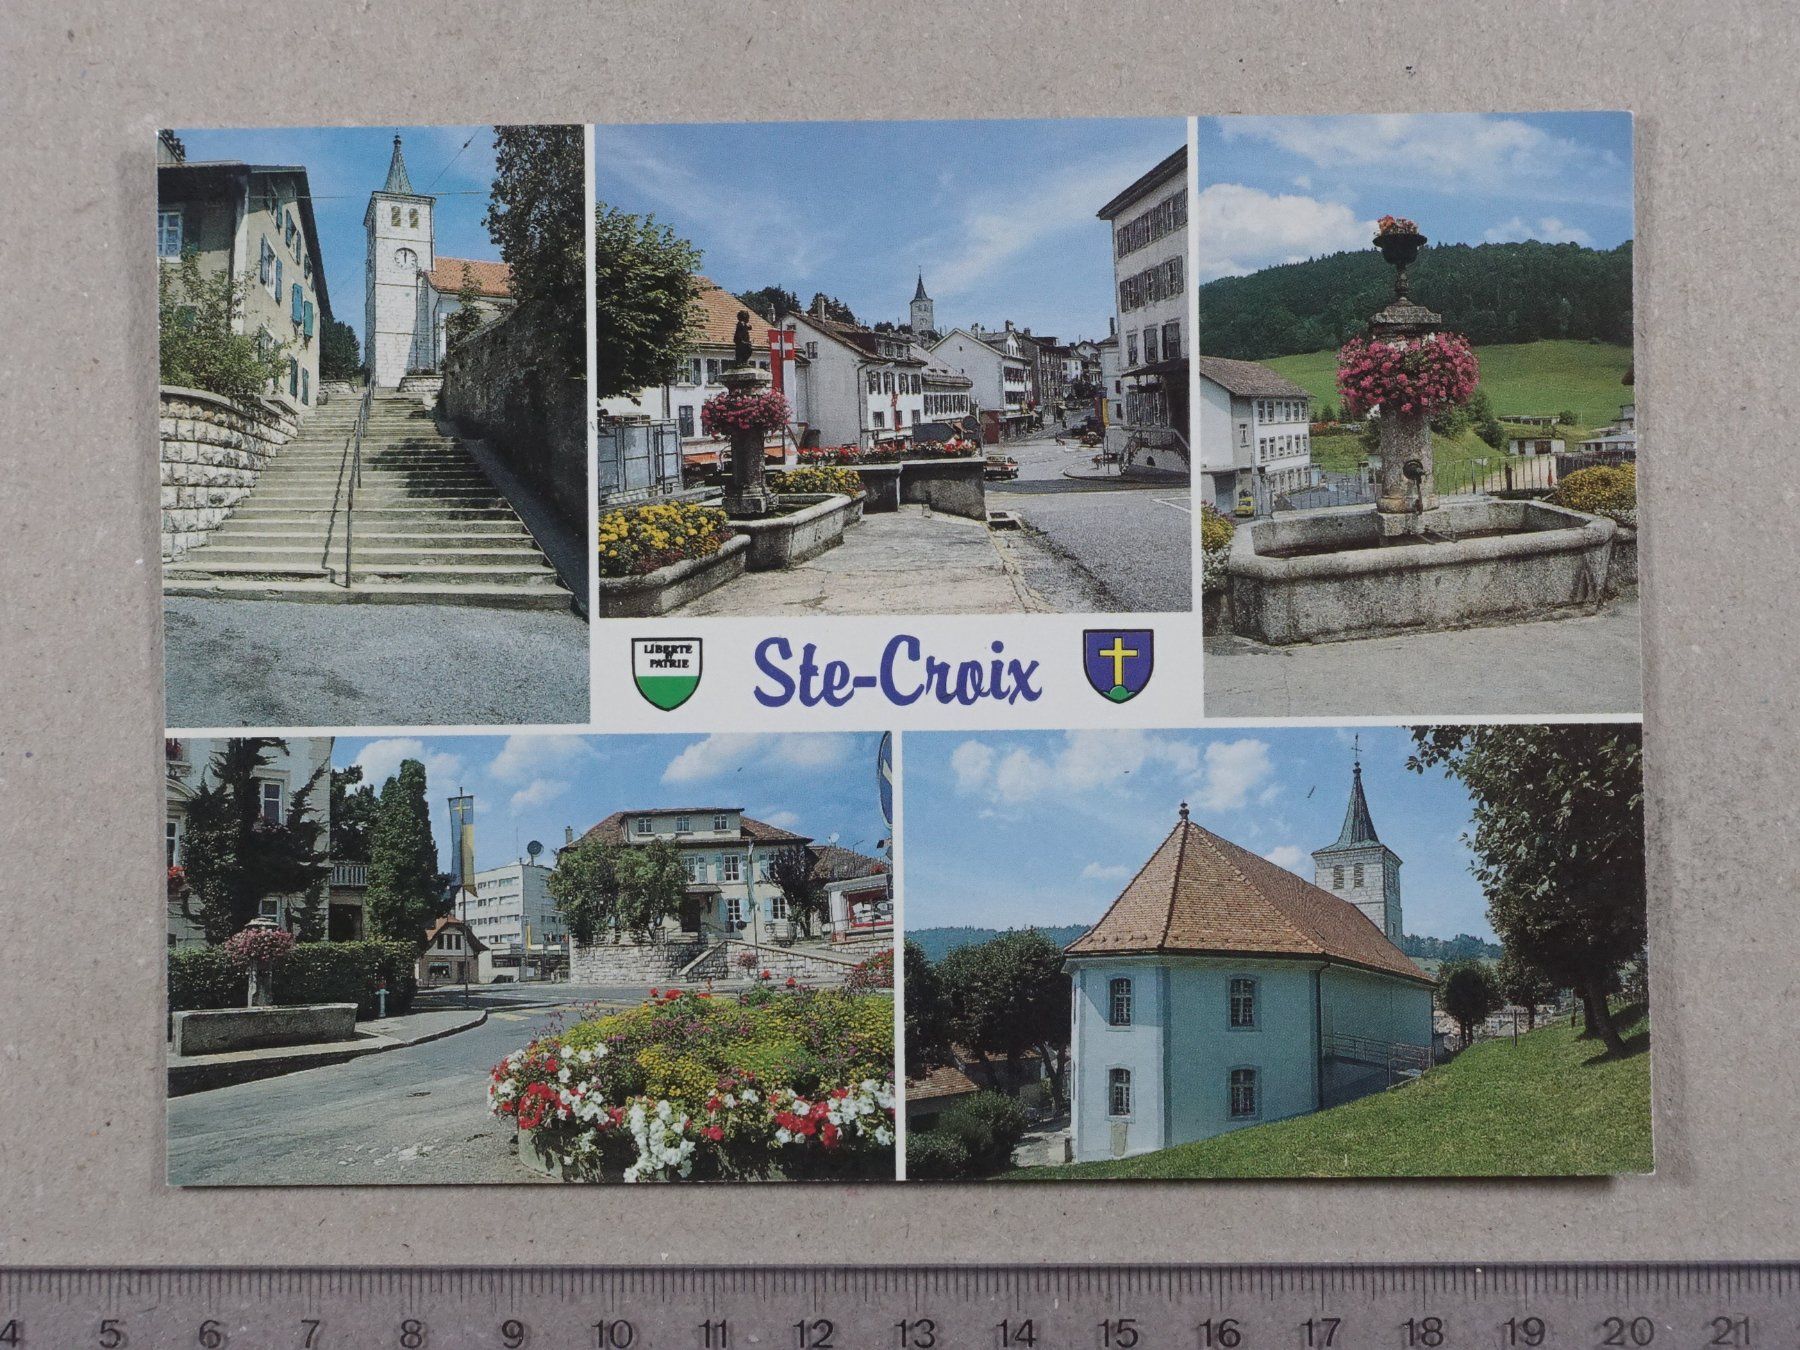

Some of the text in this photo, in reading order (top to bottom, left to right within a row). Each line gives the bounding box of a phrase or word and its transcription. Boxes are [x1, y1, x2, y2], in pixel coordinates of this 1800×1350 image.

[649, 659, 690, 668] PATRIE
[753, 634, 1042, 707] Ste-Croix
[0, 1316, 1750, 1349] 4 5 6 7 8 9 10 11 12 13 14 15 16 17 18 19 20 21
